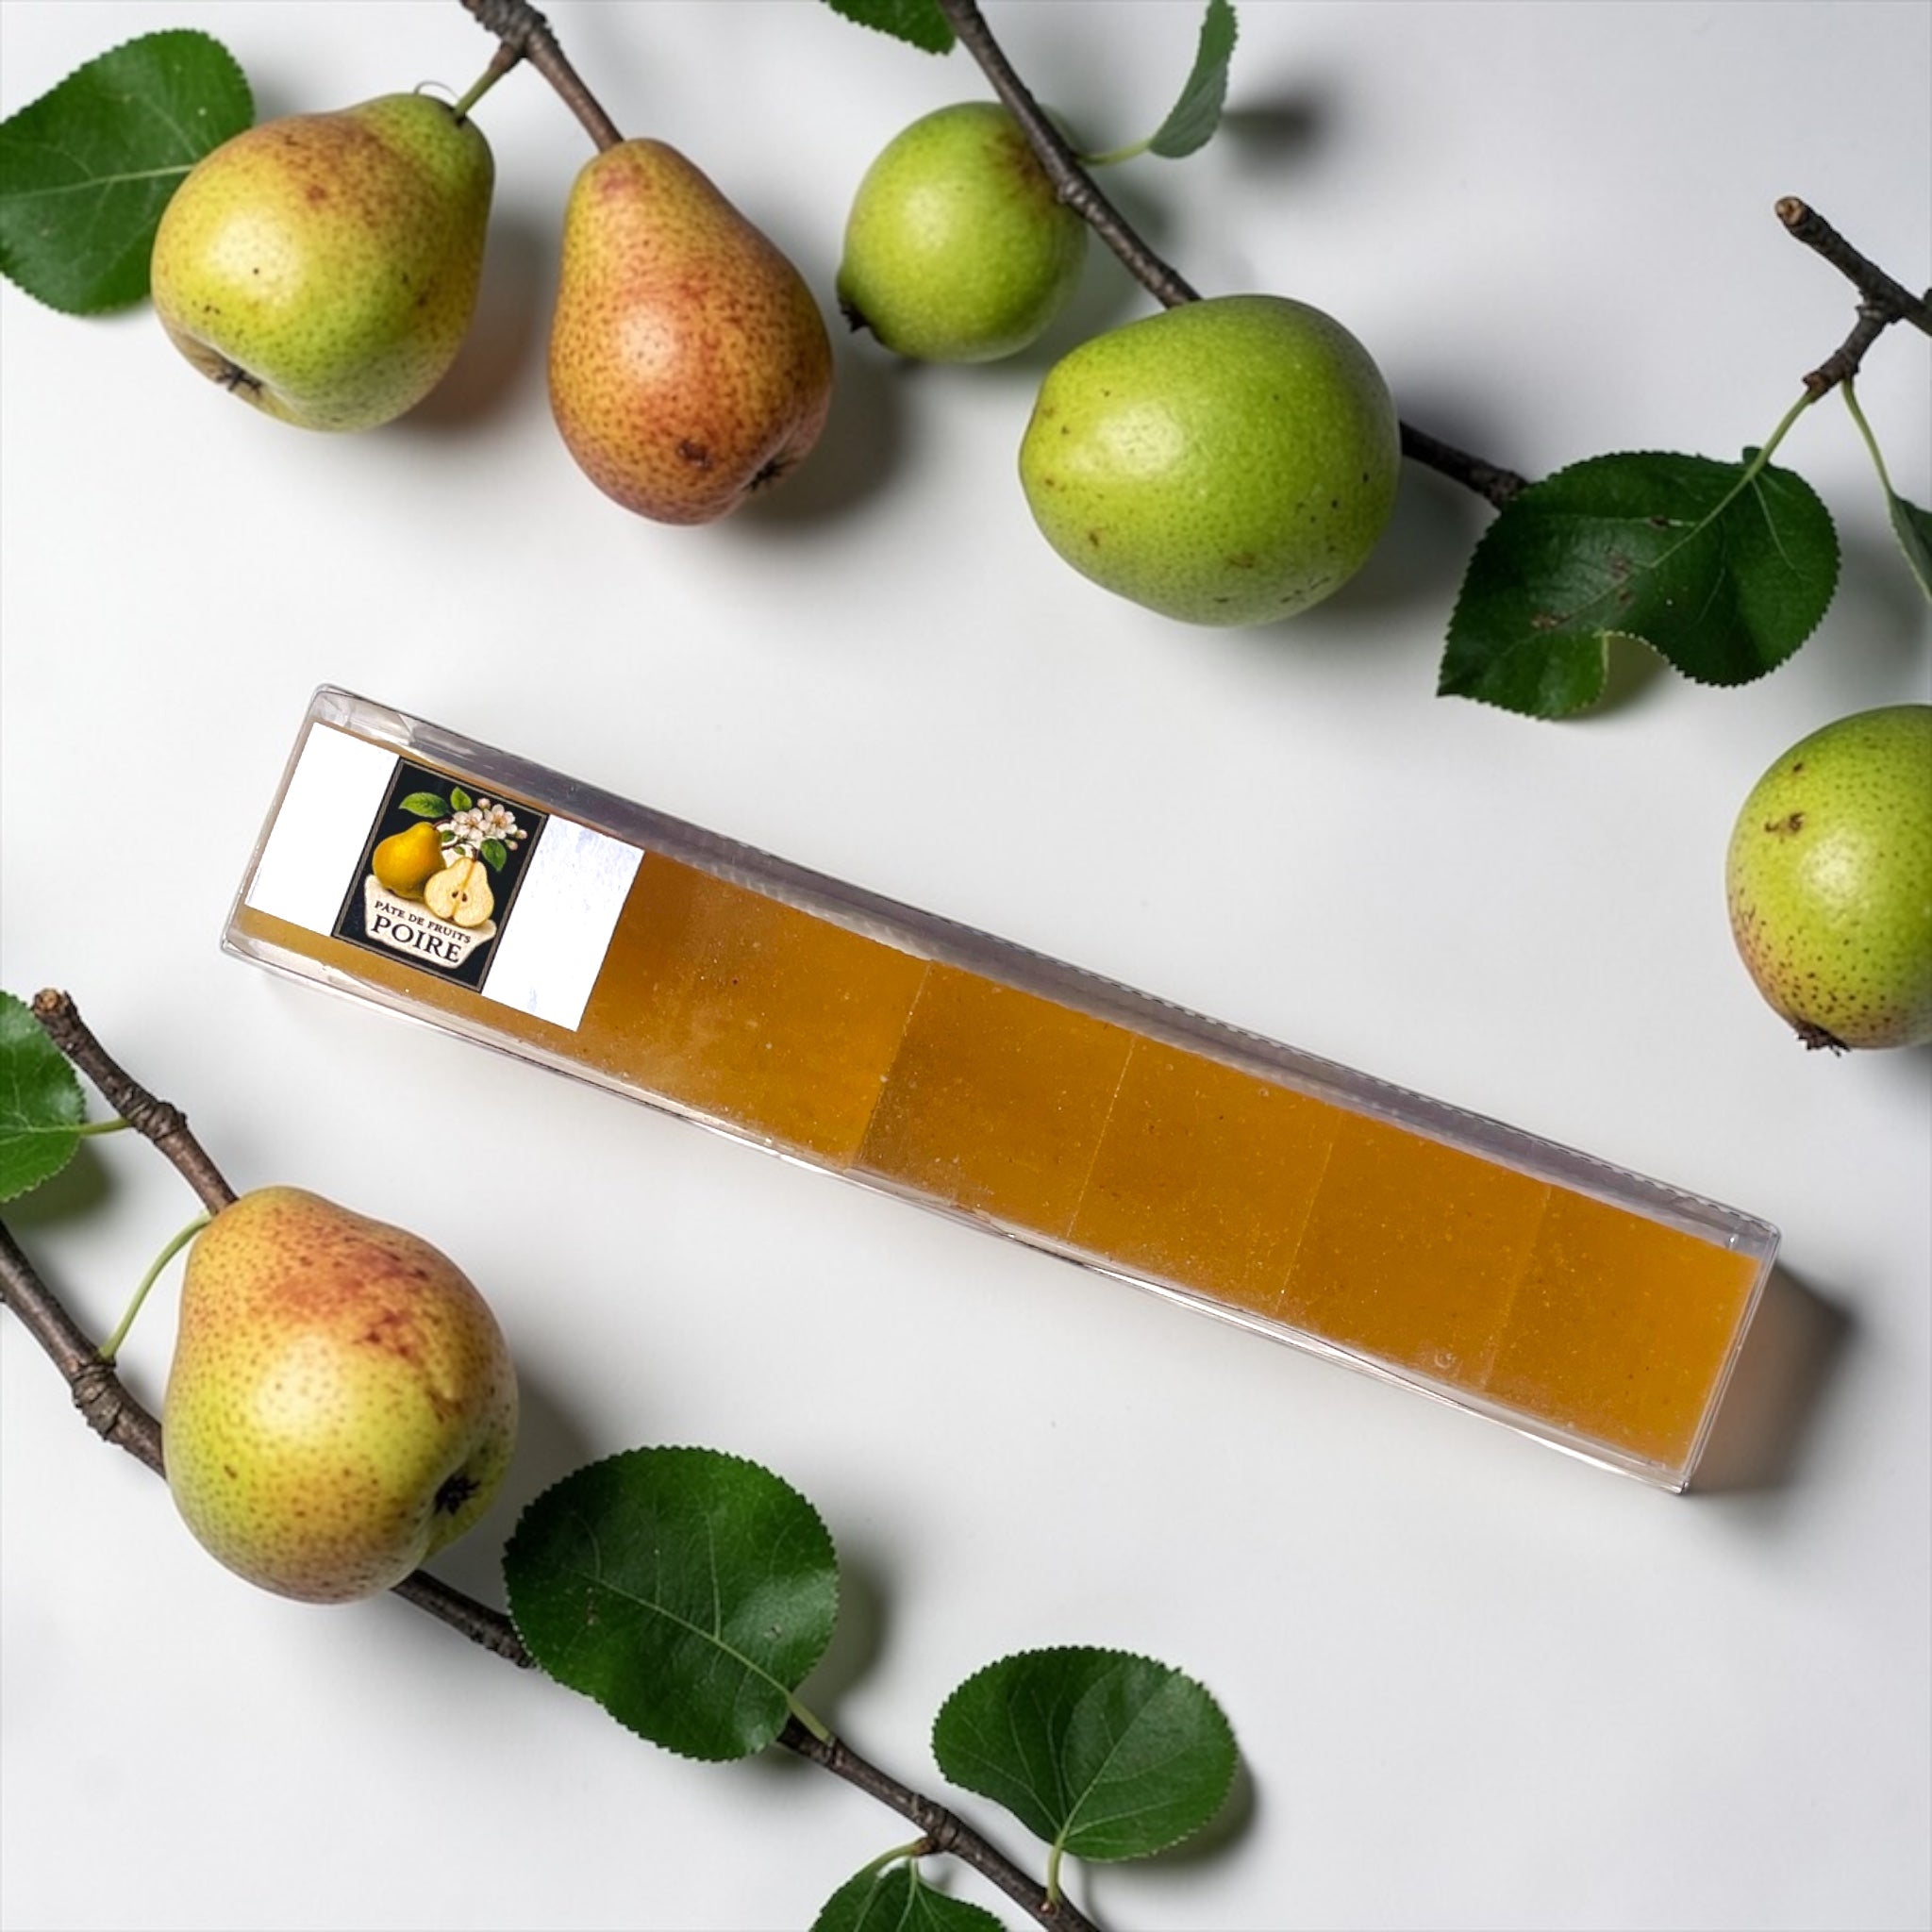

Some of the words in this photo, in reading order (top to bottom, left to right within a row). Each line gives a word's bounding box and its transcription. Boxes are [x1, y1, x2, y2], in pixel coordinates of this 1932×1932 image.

[371, 914, 462, 963] POIRE
[375, 900, 405, 918] PÂTE
[408, 913, 425, 925] DE
[427, 922, 472, 944] FRUITS
